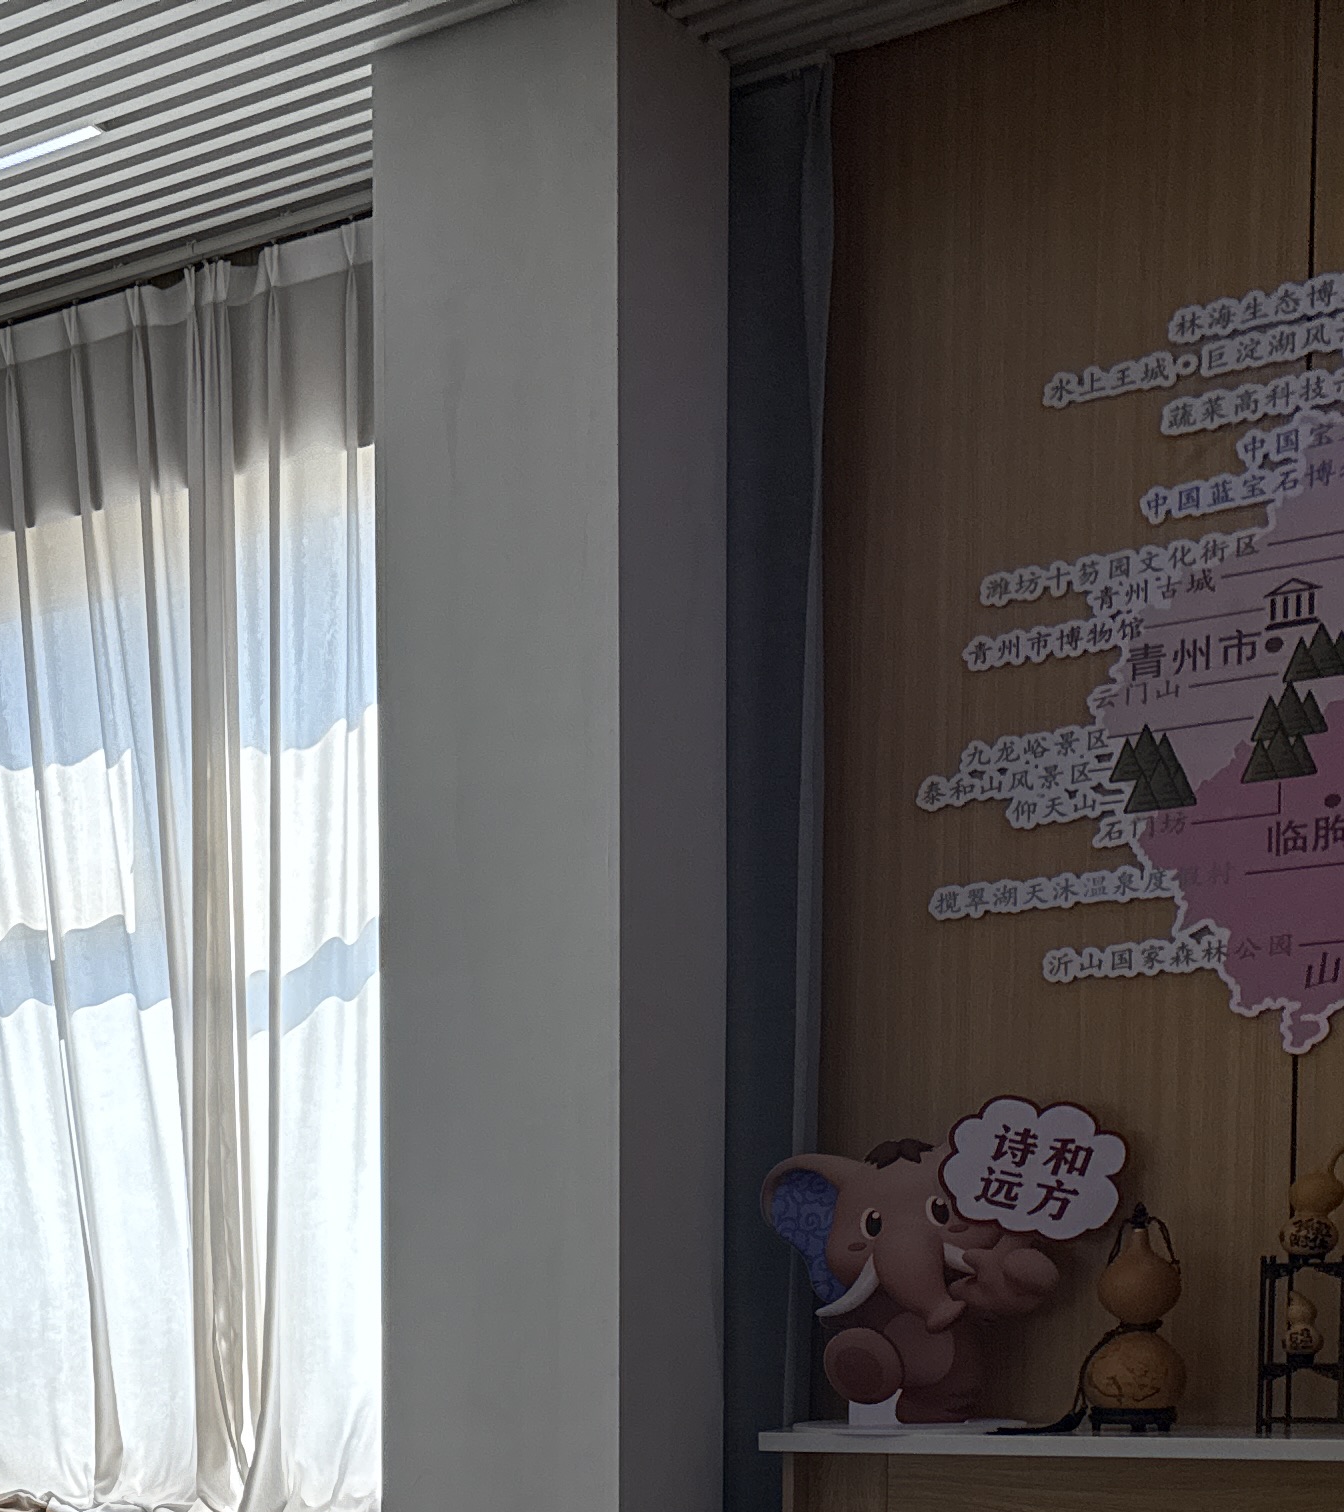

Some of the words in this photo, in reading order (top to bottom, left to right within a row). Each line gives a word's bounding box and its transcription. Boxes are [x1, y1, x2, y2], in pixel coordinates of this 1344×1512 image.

[1174, 280, 1344, 337] 林海生态博
[1049, 356, 1171, 402] 水上王城
[1243, 423, 1344, 463] 中国宝
[1146, 459, 1344, 517] 中国蓝宝石博
[1095, 567, 1217, 609] 青州古城
[968, 616, 1145, 665] 青州市博物馆
[1126, 630, 1262, 679] 青州市
[1092, 682, 1181, 709] 云门山
[967, 728, 1109, 766] 九龙峪景区
[922, 761, 1092, 804] 泰和山风景区
[1012, 794, 1097, 823] 仰天山
[1099, 811, 1188, 842] 石门坊
[1048, 933, 1293, 977] 沂山国家森林公园
[990, 1124, 1095, 1177] 诗和
[974, 1167, 1080, 1220] 远方
